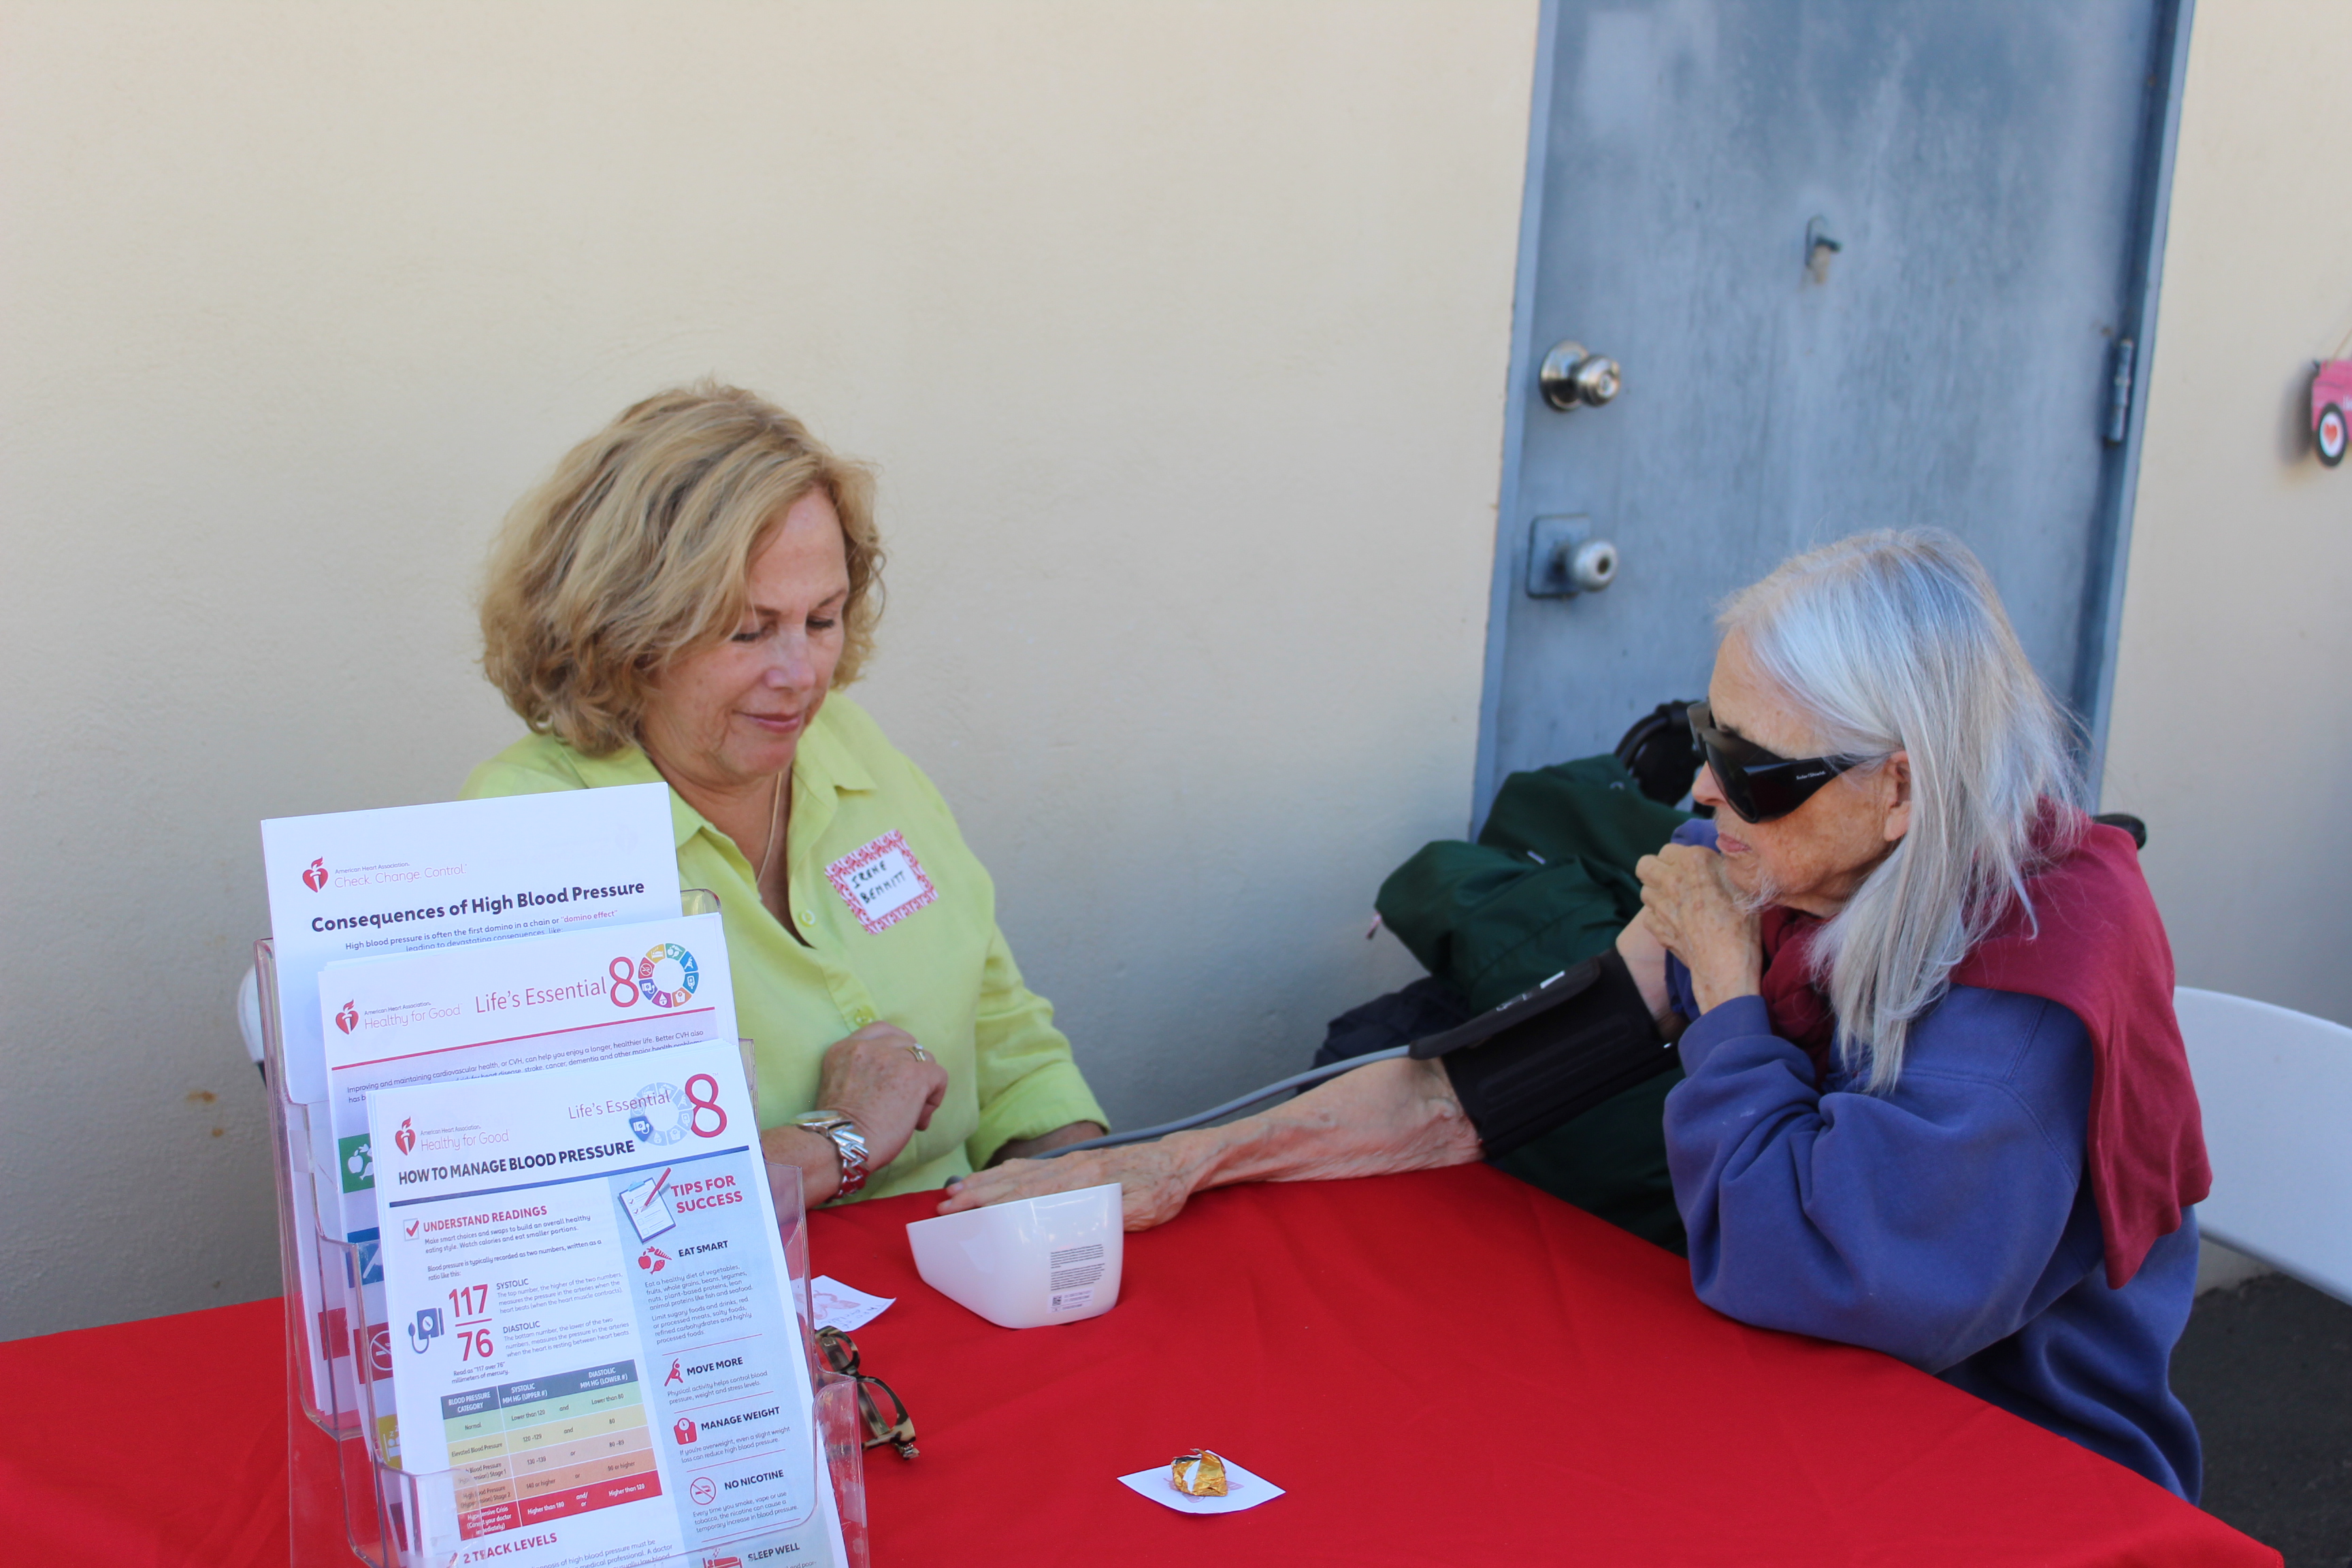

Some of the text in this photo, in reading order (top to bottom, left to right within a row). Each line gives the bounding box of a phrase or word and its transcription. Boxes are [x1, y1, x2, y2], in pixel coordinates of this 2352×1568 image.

[334, 874, 372, 887] Check.
[375, 871, 421, 883] Change.
[312, 883, 644, 932] Consequences of High Blood Pressure
[345, 941, 364, 950] High
[365, 937, 389, 947] blood
[390, 935, 422, 945] pressure
[484, 924, 512, 932] domino
[529, 918, 550, 926] chain
[561, 914, 591, 922] "domino
[593, 910, 617, 919] effect"
[476, 956, 640, 1013] Life's Essential 8
[364, 1003, 460, 1029] Healthy for Good
[347, 1083, 378, 1093] Improving
[393, 1074, 431, 1084] maintaining
[432, 1066, 476, 1078] cardiovascular
[478, 1061, 500, 1070] health,
[590, 1045, 612, 1057] longer,
[612, 1039, 641, 1048] healthier
[568, 1073, 728, 1139] Life's Essential 8
[421, 1128, 508, 1151] Healthy for Good
[399, 1139, 635, 1185] HOW TO MANAGE BLOOD PRESSURE
[670, 1175, 736, 1196] TIPS FOR
[676, 1190, 742, 1213] SUCCESS
[423, 1205, 547, 1232] UNDERSTAND READINGS
[542, 1218, 564, 1226] overall
[565, 1215, 590, 1223] healthy
[678, 1240, 728, 1256] EAT SMART
[496, 1278, 529, 1290] SYSTOLIC
[661, 1275, 685, 1284] healthy
[706, 1264, 740, 1275] vegetables,
[448, 1284, 487, 1317] 117
[502, 1320, 540, 1333] DIASTOLIC
[457, 1328, 493, 1361] 76
[588, 1367, 616, 1378] DIASTOLIC
[687, 1356, 742, 1375] MOVE MORE
[510, 1382, 535, 1393] SYSTOLIC
[600, 1375, 621, 1385] (LOWER
[667, 1386, 691, 1396] Physical
[691, 1383, 713, 1391] activity
[730, 1373, 750, 1383] control
[750, 1370, 767, 1378] blood
[448, 1391, 490, 1405] BLOOD PRESSURE
[521, 1390, 540, 1401] (UPPER
[457, 1401, 483, 1413] CATEGORY
[465, 1422, 481, 1430] Normal
[700, 1406, 779, 1431] MANAGE WEIGHT
[724, 1469, 783, 1490] NO NICOTINE
[576, 1491, 587, 1499] and/
[608, 1488, 624, 1497] Higher
[527, 1507, 543, 1515] Higher
[463, 1553, 470, 1563] 2
[514, 1533, 557, 1551] LEVELS
[747, 1542, 800, 1561] SLEEP WELL
